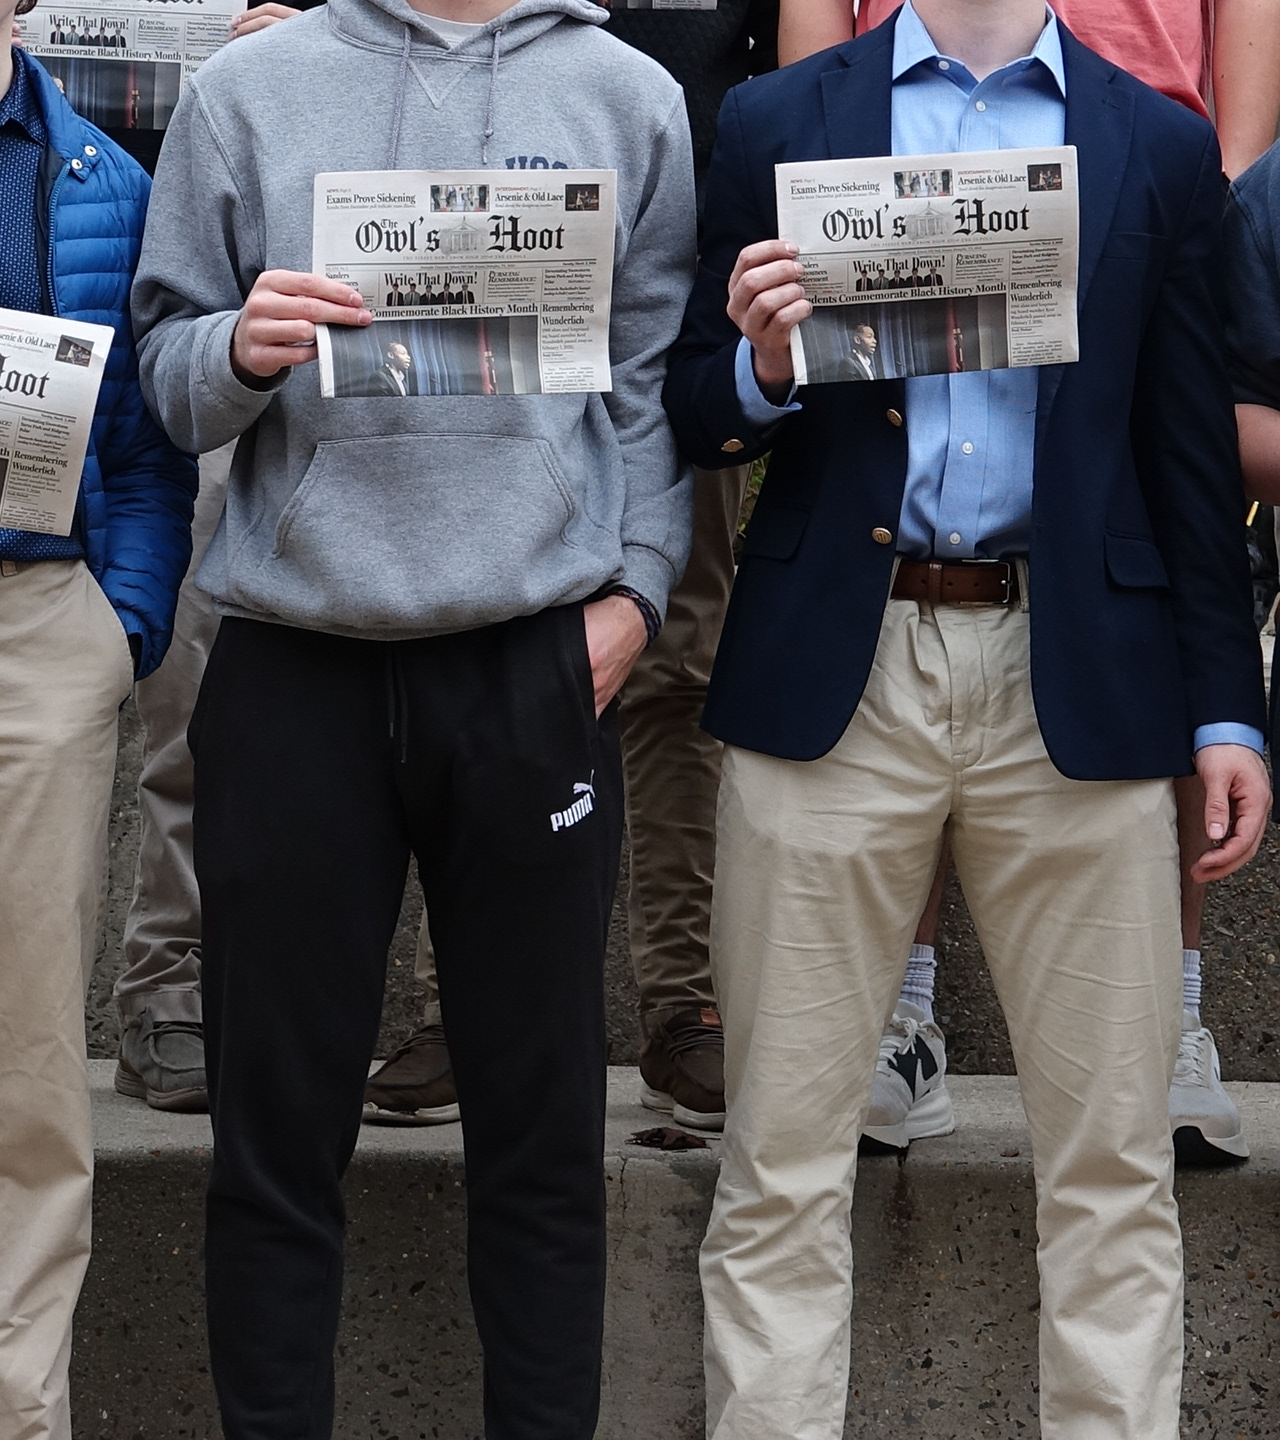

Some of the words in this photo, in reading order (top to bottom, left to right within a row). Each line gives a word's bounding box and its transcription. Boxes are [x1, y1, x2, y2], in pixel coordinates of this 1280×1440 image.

[958, 176, 988, 186] Arsenic
[994, 174, 1009, 183] Old
[1010, 174, 1026, 182] Lace
[790, 185, 817, 195] Exams
[818, 184, 841, 193] Prove
[841, 181, 881, 192] Sickening
[326, 194, 352, 204] Exams
[353, 194, 376, 203] Prove
[377, 193, 416, 204] Sickening
[495, 193, 525, 202] Arsenic
[532, 193, 546, 201] Old
[547, 193, 564, 201] Lace
[846, 207, 864, 218] The
[952, 198, 1030, 235] Hoot
[380, 219, 398, 230] The
[822, 203, 907, 242] Owl's
[355, 215, 441, 253] Owl's
[486, 215, 565, 252] Hoot
[852, 260, 882, 273] Write
[883, 257, 909, 271] That
[912, 255, 945, 270] Down!
[384, 273, 413, 286] Write
[415, 272, 441, 286] That
[444, 271, 477, 285] Down!
[1011, 279, 1062, 290] Remembering
[838, 289, 908, 303] Commemorate
[910, 287, 936, 298] Black
[938, 286, 973, 296] History
[976, 282, 1006, 293] Month
[1010, 291, 1053, 303] Wunderlich
[369, 307, 439, 318] Commemorate
[441, 305, 467, 316] Black
[469, 305, 504, 316] History
[507, 303, 538, 314] Month
[542, 302, 594, 313] Remembering
[542, 315, 585, 326] Wunderlich
[550, 792, 593, 832] PUMA
